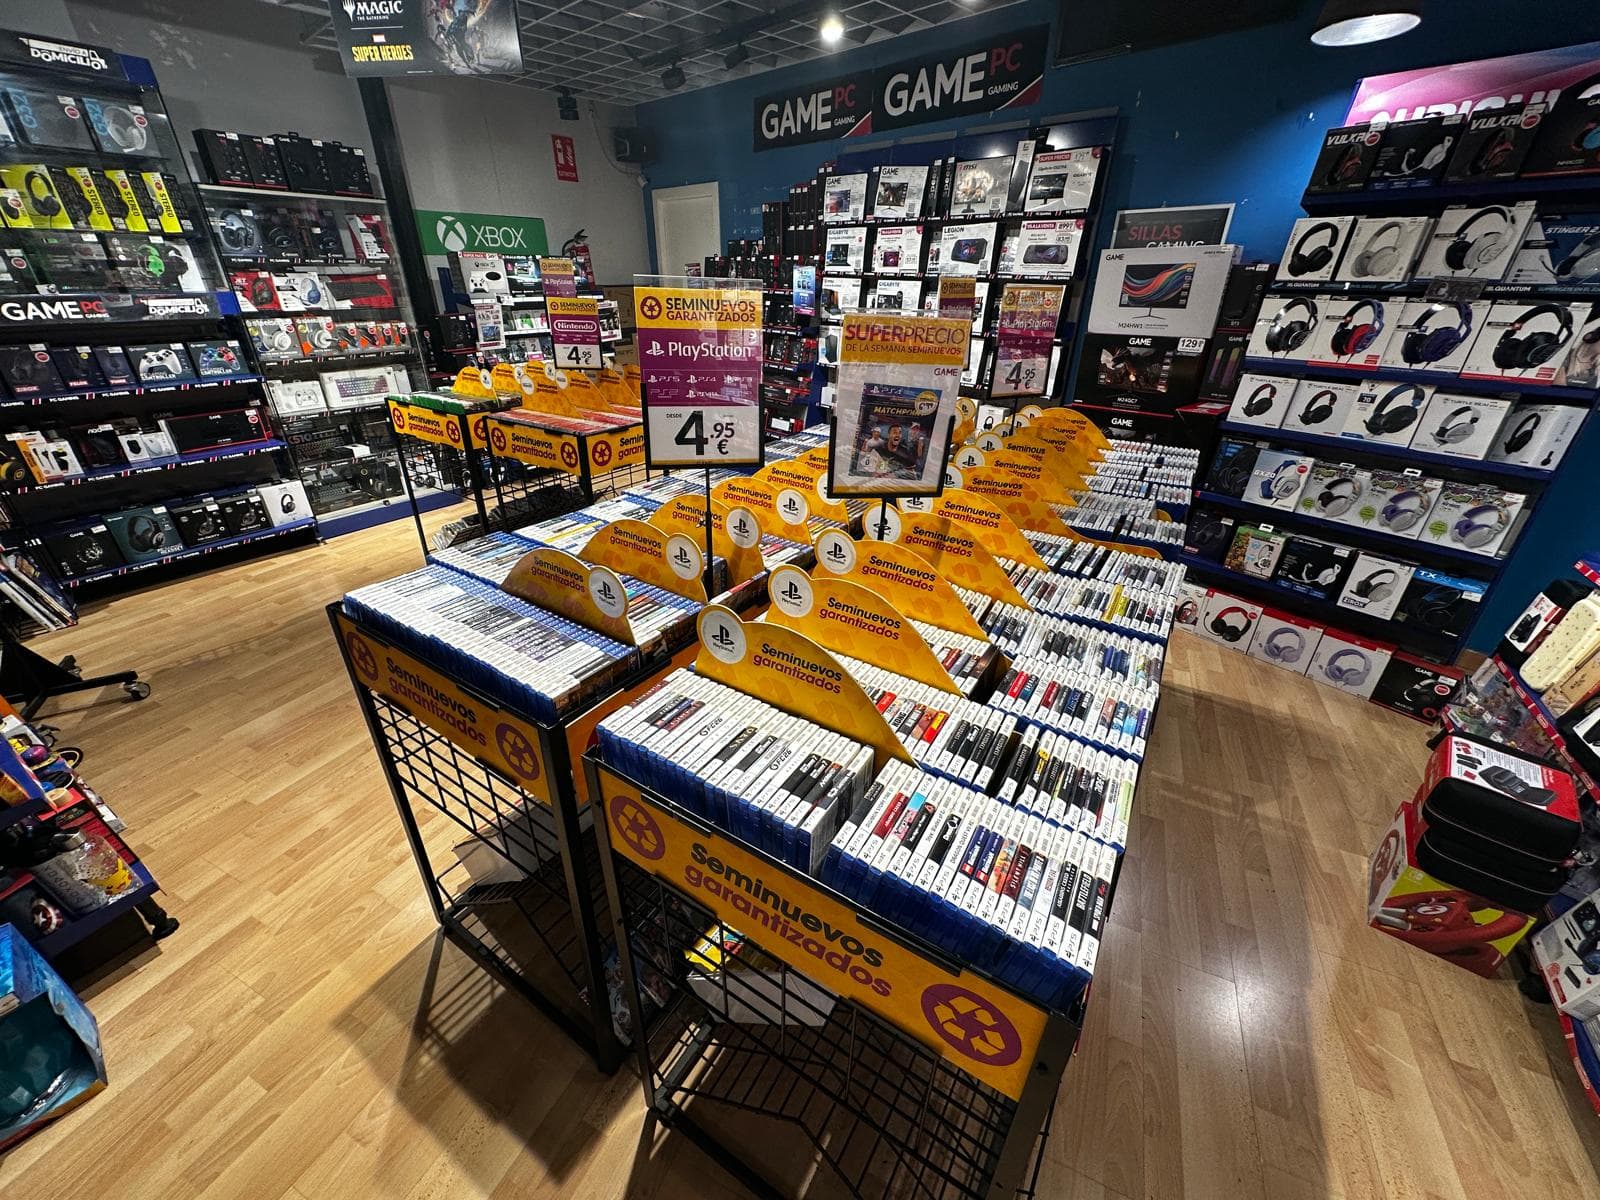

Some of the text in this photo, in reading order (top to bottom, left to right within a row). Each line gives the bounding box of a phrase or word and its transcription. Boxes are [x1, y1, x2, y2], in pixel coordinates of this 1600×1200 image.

[356, 0, 404, 15] MAGIC
[352, 45, 414, 62] SUPER HEROES
[884, 43, 1023, 117] GAME PC
[987, 82, 1019, 96] GAMING
[761, 84, 856, 139] GAME PC
[834, 115, 856, 127] GAMING
[471, 225, 527, 248] XBOX
[1128, 225, 1182, 241] SILLAS
[1546, 226, 1589, 234] STINGER
[1, 300, 107, 321] GAME PC
[666, 298, 756, 312] SEMINUEVOS
[666, 311, 756, 322] GARANTIZADOS
[845, 323, 965, 345] SUPERPRECIO
[1129, 338, 1152, 346] GAME
[668, 342, 752, 361] PlayStation
[845, 344, 961, 355] DE LA SEMANA SEMINUEVOS
[934, 367, 958, 377] GAME
[408, 412, 440, 427] Seminuevos
[408, 421, 444, 437] garantizados
[1111, 418, 1133, 427] GAME
[511, 432, 553, 450] Seminuevos
[619, 435, 645, 447] Semin
[674, 410, 735, 455] 4.95 €
[511, 442, 556, 460] garantizados
[771, 467, 814, 483] Seminuevos
[994, 459, 1042, 473] Seminuevos
[727, 483, 772, 501] Seminuevos
[766, 474, 814, 491] garantizados
[966, 485, 1022, 498] garantizados
[972, 478, 1023, 490] Seminuevos
[723, 491, 772, 509] garantizados
[937, 509, 999, 529] garantizados
[945, 500, 1002, 520] Seminuevos
[609, 535, 662, 558] garantizados
[613, 526, 662, 549] Seminuevos
[905, 534, 973, 558] garantizados
[912, 526, 974, 549] Seminuevos
[533, 556, 583, 582] Seminuevos
[862, 563, 934, 592] garantizados
[869, 555, 936, 582] Seminuevos
[1420, 570, 1437, 579] TX
[531, 566, 585, 593] garantizados
[827, 597, 901, 629] Seminuevos
[819, 606, 900, 640] garantizados
[761, 643, 843, 682] Seminuevos
[753, 653, 841, 694] garantizados
[386, 656, 477, 724] Seminuevos
[389, 677, 487, 747] garantizados
[891, 710, 907, 728] KONG
[774, 747, 793, 765] FC26
[949, 843, 963, 864] DRAGON
[958, 830, 970, 845] QUEST
[1009, 867, 1022, 889] SILENT
[1017, 854, 1027, 869] HILL
[1075, 871, 1092, 910] BATTLEFIELD
[690, 843, 884, 967] Seminuevos
[684, 864, 893, 997] garantizados
